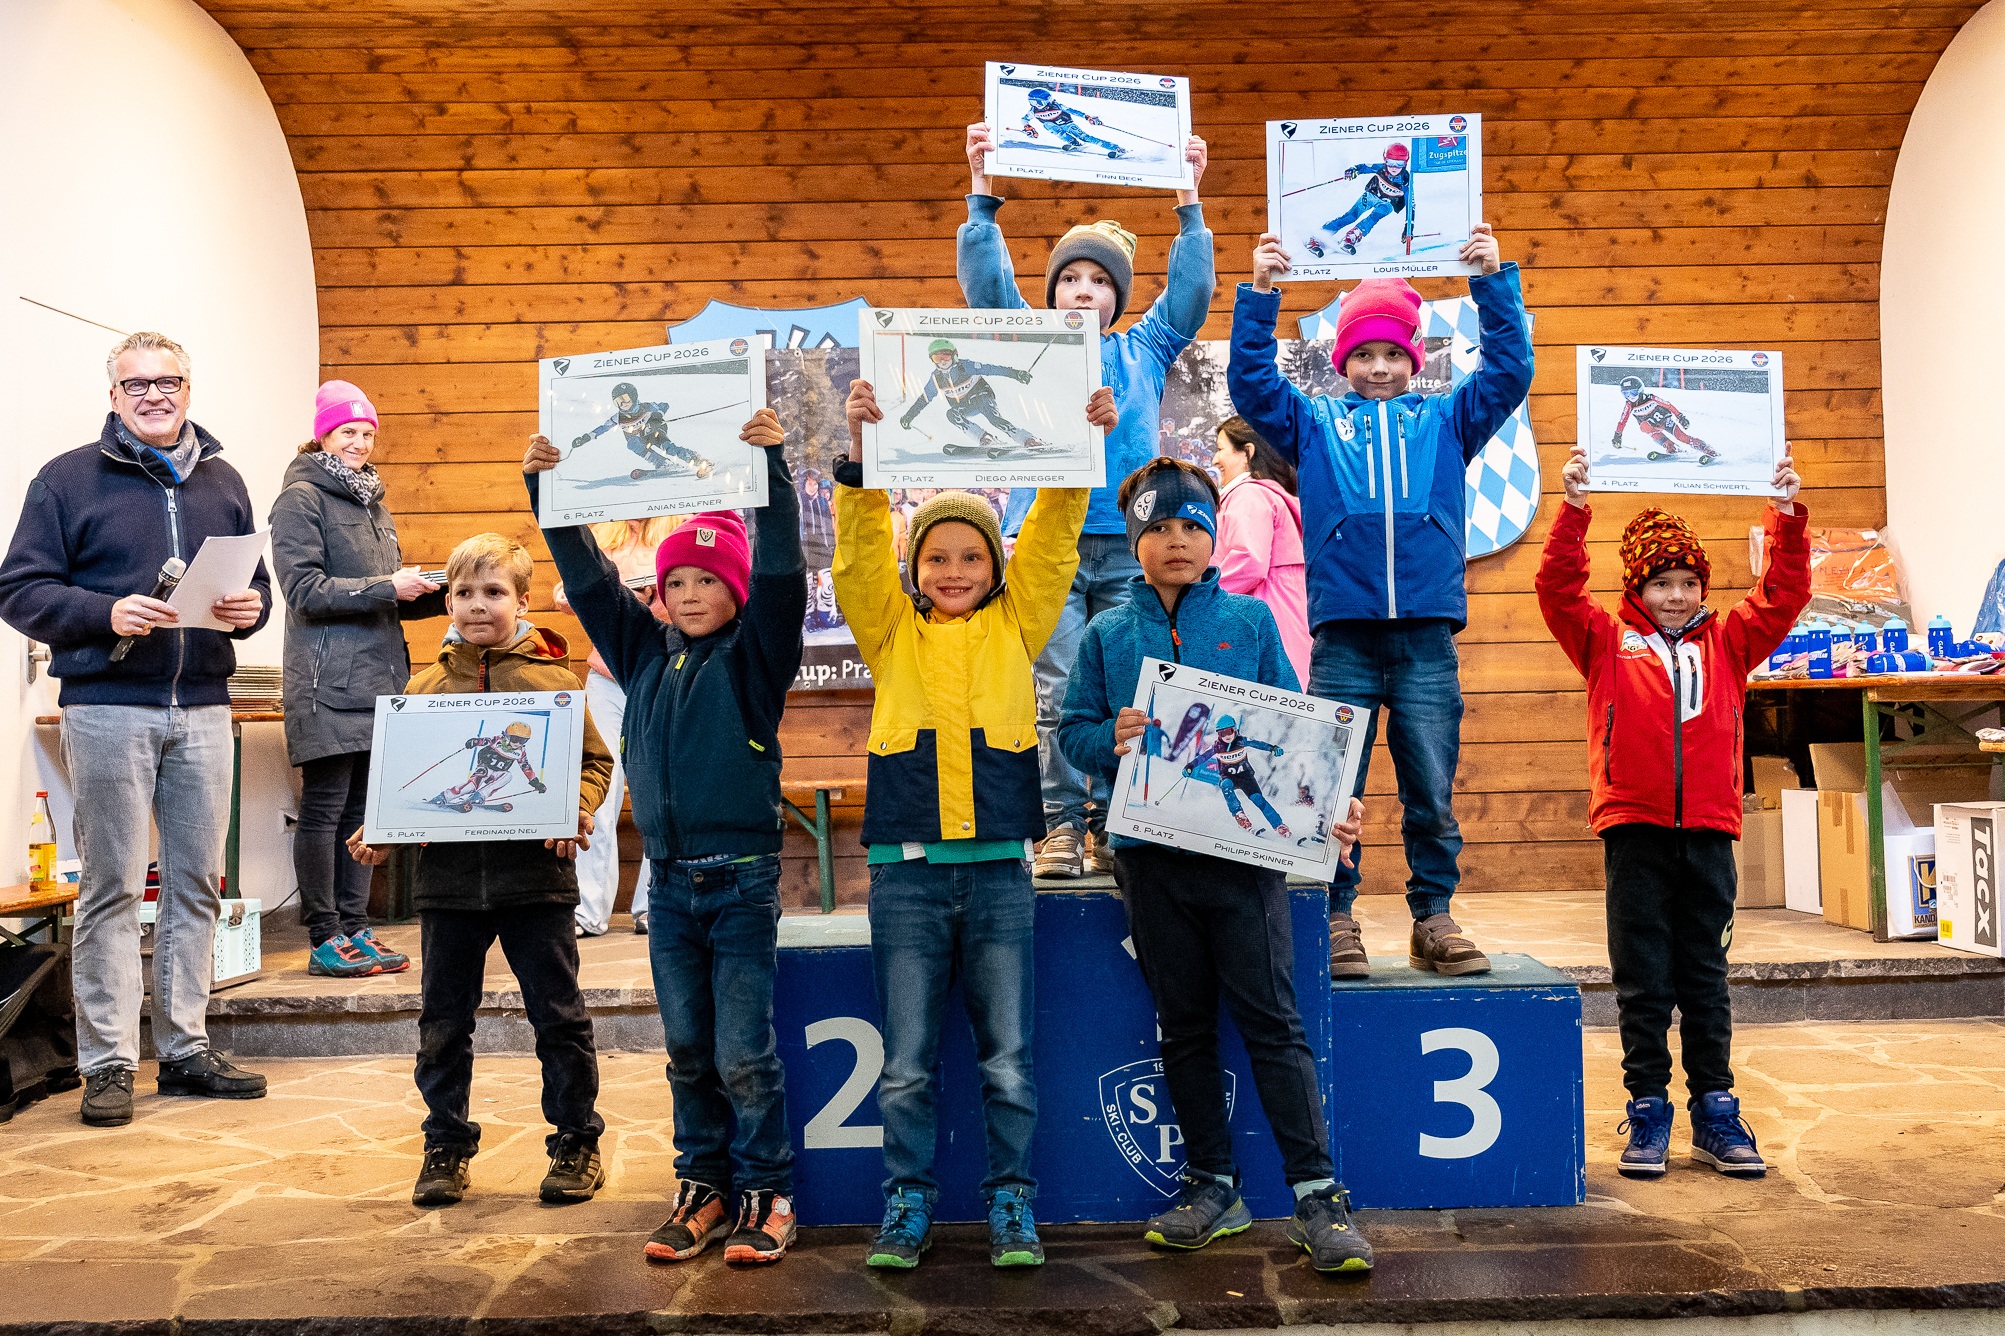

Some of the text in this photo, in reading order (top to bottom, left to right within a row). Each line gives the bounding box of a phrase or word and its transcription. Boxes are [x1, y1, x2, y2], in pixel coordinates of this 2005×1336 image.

[1036, 70, 1141, 85] ZIENER CUP 2026
[1319, 122, 1430, 134] ZIENER CUP 2026
[1016, 167, 1044, 175] PLATZ
[1096, 173, 1117, 181] FINN
[919, 315, 1043, 325] ZIENER CUP 2026
[593, 348, 709, 369] ZIENER CUP 2026
[1627, 353, 1733, 364] ZIENER CUP 2026
[1408, 377, 1441, 392] pitze
[891, 475, 934, 483] 7. PLATZ
[975, 474, 1065, 482] DIEGO ARNEGGER
[647, 498, 722, 512] ANIAN SALFNER
[564, 510, 605, 521] 6. PLATZ
[795, 665, 837, 687] up:
[1198, 677, 1315, 713] ZIENER CUP 2026
[427, 697, 535, 708] ZIENER CUP 2026
[1132, 824, 1175, 840] 8. PLATZ
[1214, 842, 1294, 867] PHILIPP SKINNER
[1973, 827, 1991, 938] Tacx
[804, 1017, 884, 1149] 2
[1418, 1027, 1502, 1159] 3
